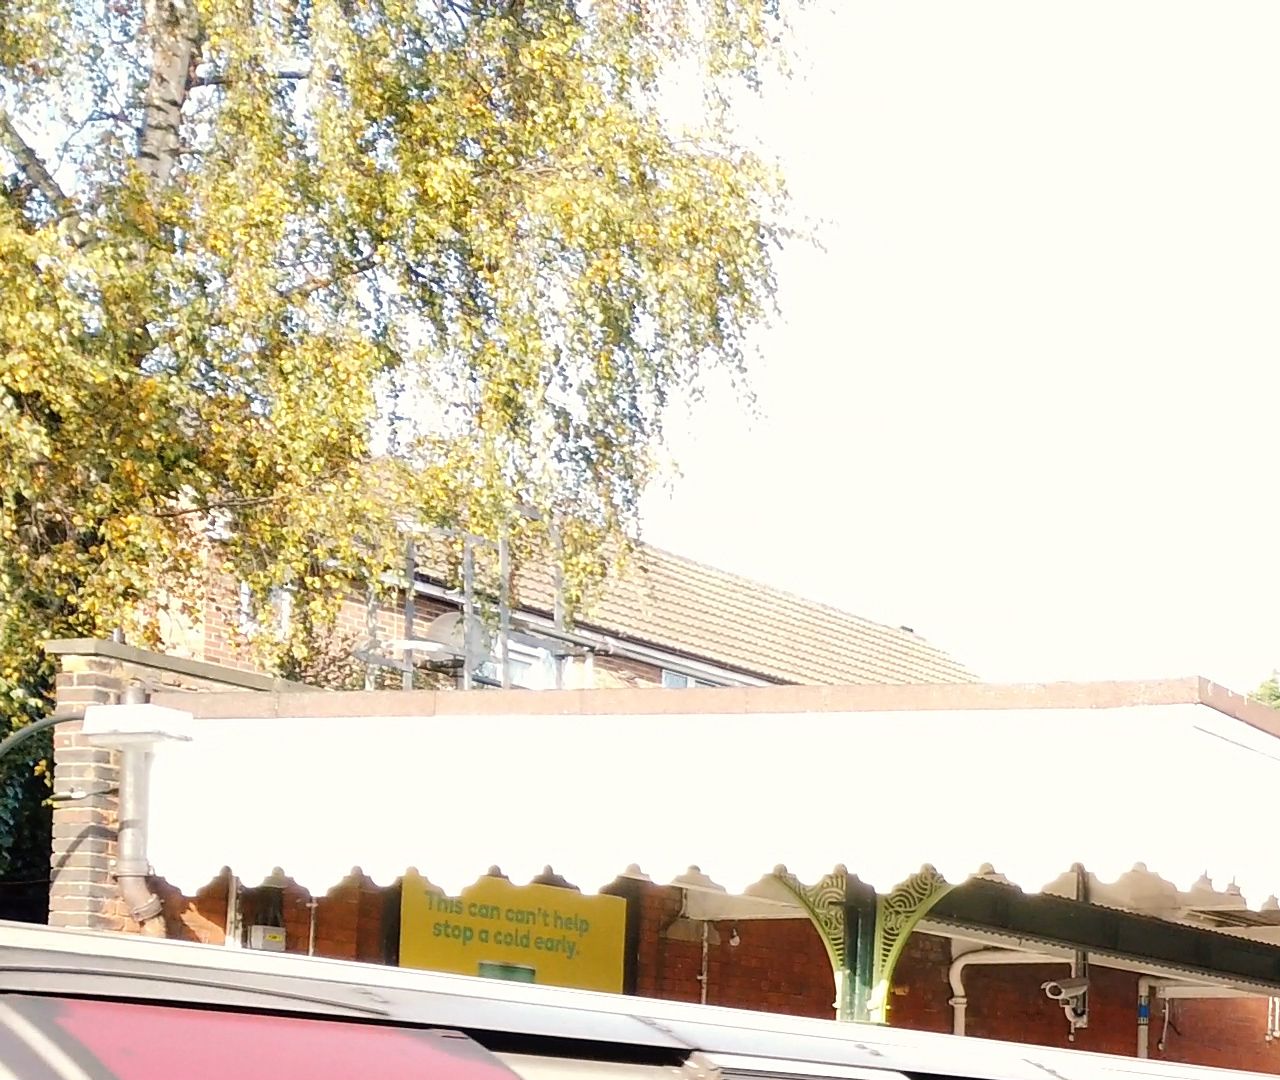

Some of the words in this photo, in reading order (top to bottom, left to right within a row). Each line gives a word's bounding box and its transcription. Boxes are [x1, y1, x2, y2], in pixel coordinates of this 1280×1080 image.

[424, 889, 464, 915] This
[468, 902, 500, 920] can
[505, 907, 550, 928] can't
[553, 909, 590, 938] help
[433, 919, 474, 946] stop
[478, 928, 489, 943] a
[494, 928, 530, 948] cold
[534, 934, 580, 960] early.
